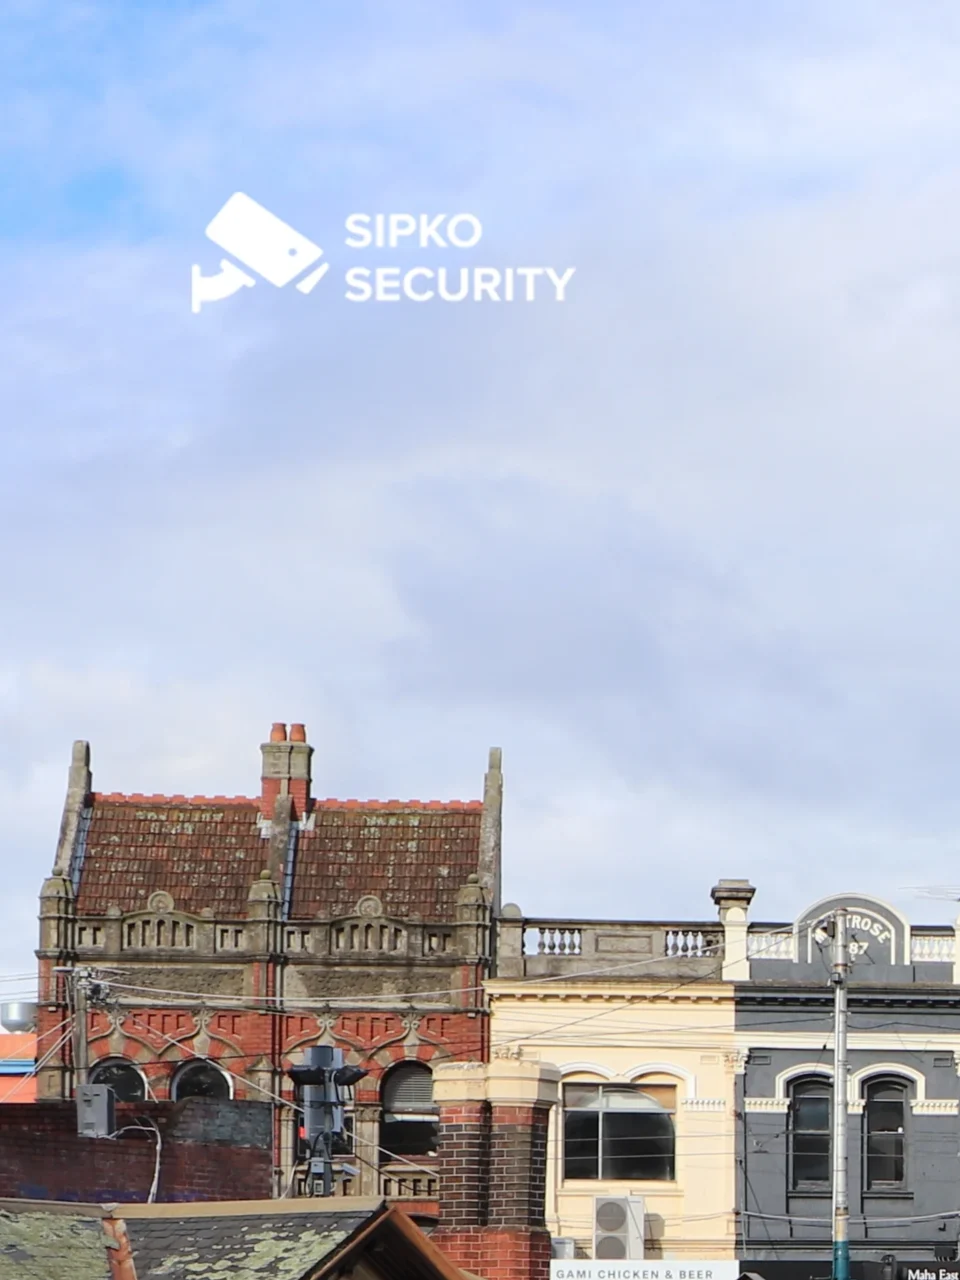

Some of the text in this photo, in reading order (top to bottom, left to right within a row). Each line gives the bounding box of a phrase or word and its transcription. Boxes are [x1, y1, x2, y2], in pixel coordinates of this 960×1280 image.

[814, 914, 891, 944] MTROSE
[556, 1269, 713, 1279] GAMI CHICKEN & BEER
[908, 1269, 959, 1280] Maha East
